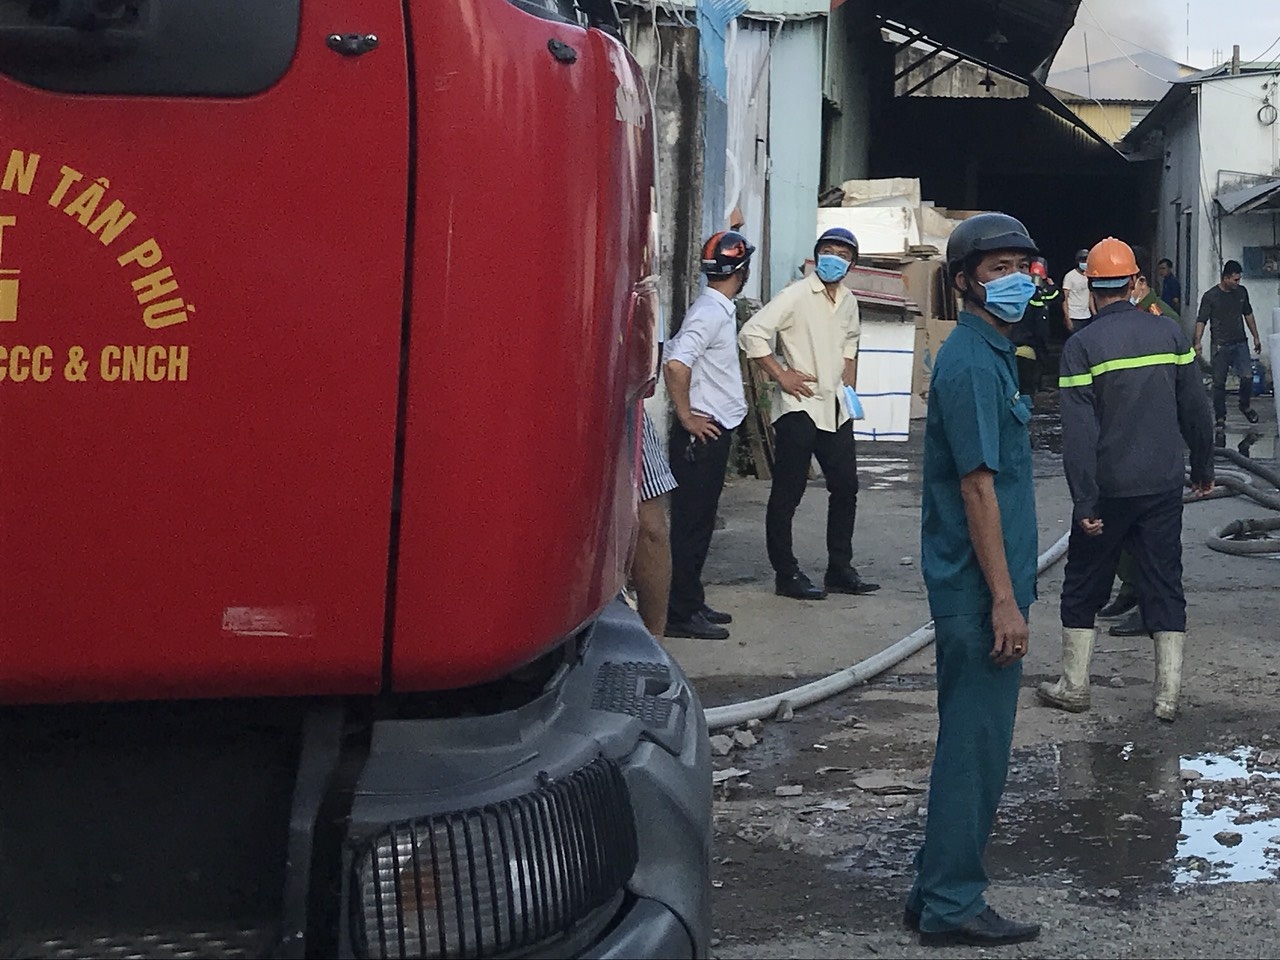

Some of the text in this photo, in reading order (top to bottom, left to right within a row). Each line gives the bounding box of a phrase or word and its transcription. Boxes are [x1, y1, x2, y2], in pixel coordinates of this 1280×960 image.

[48, 165, 137, 246] TÂN
[117, 238, 196, 329] PHÚ
[64, 345, 89, 381] &
[101, 345, 189, 381] CNCH
